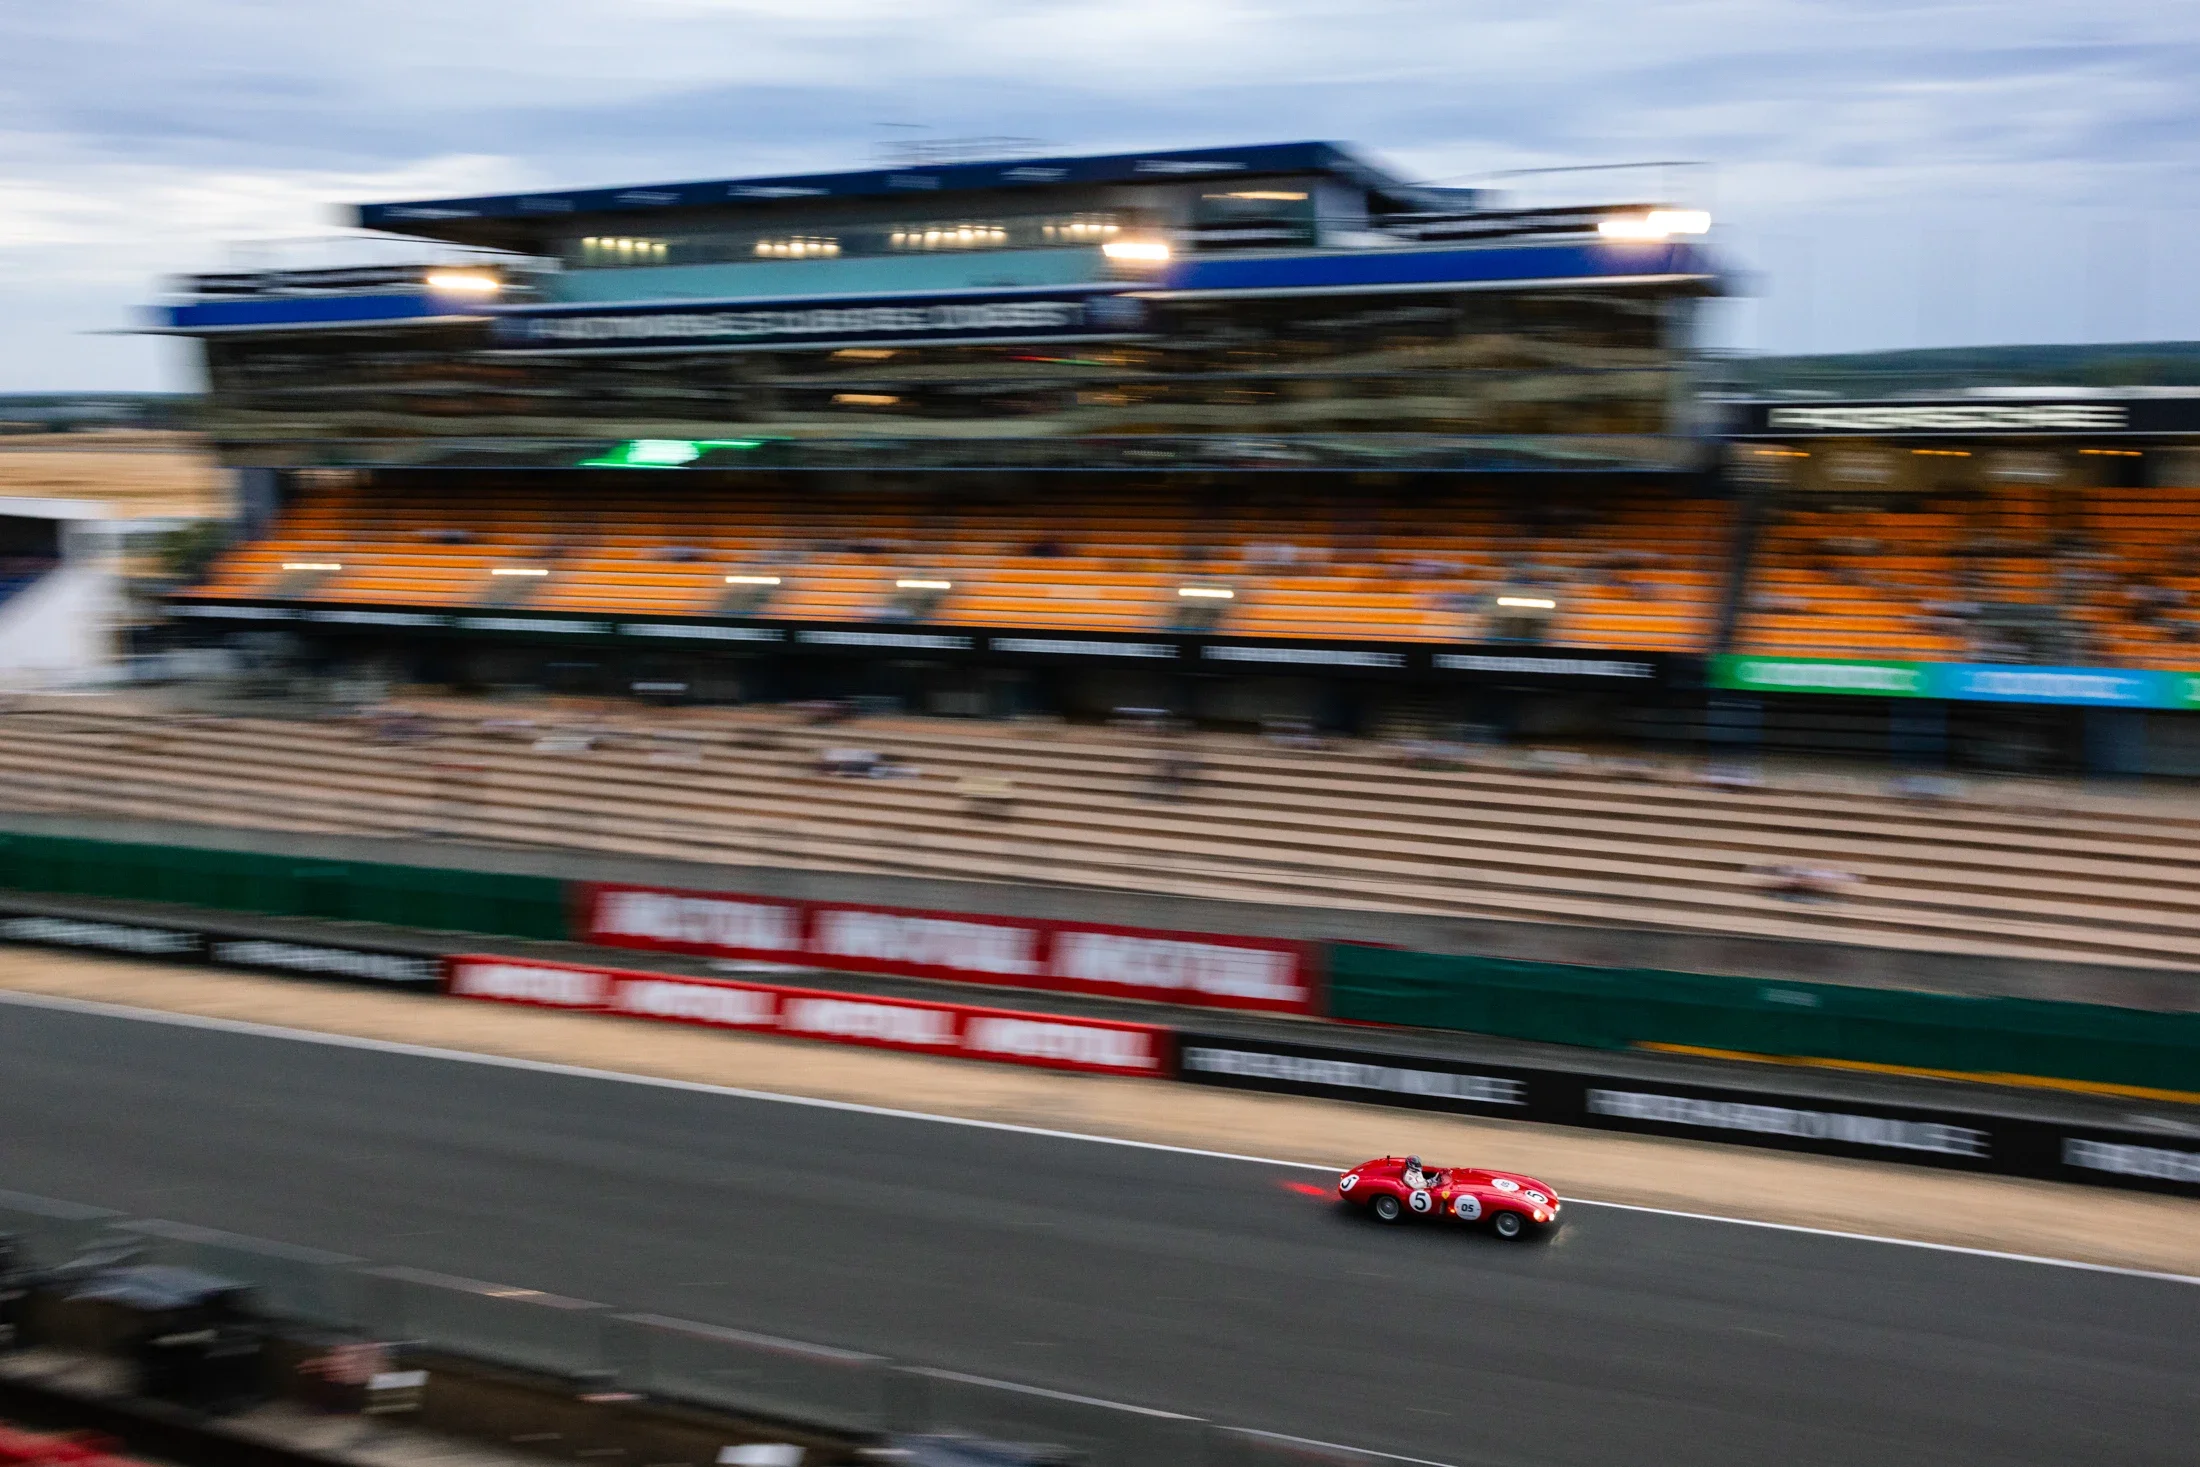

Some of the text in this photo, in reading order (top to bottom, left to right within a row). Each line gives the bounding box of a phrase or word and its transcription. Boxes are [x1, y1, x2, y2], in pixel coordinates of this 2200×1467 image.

[1414, 1192, 1427, 1211] 5
[1526, 1191, 1545, 1202] 5
[1461, 1203, 1474, 1213] 05
